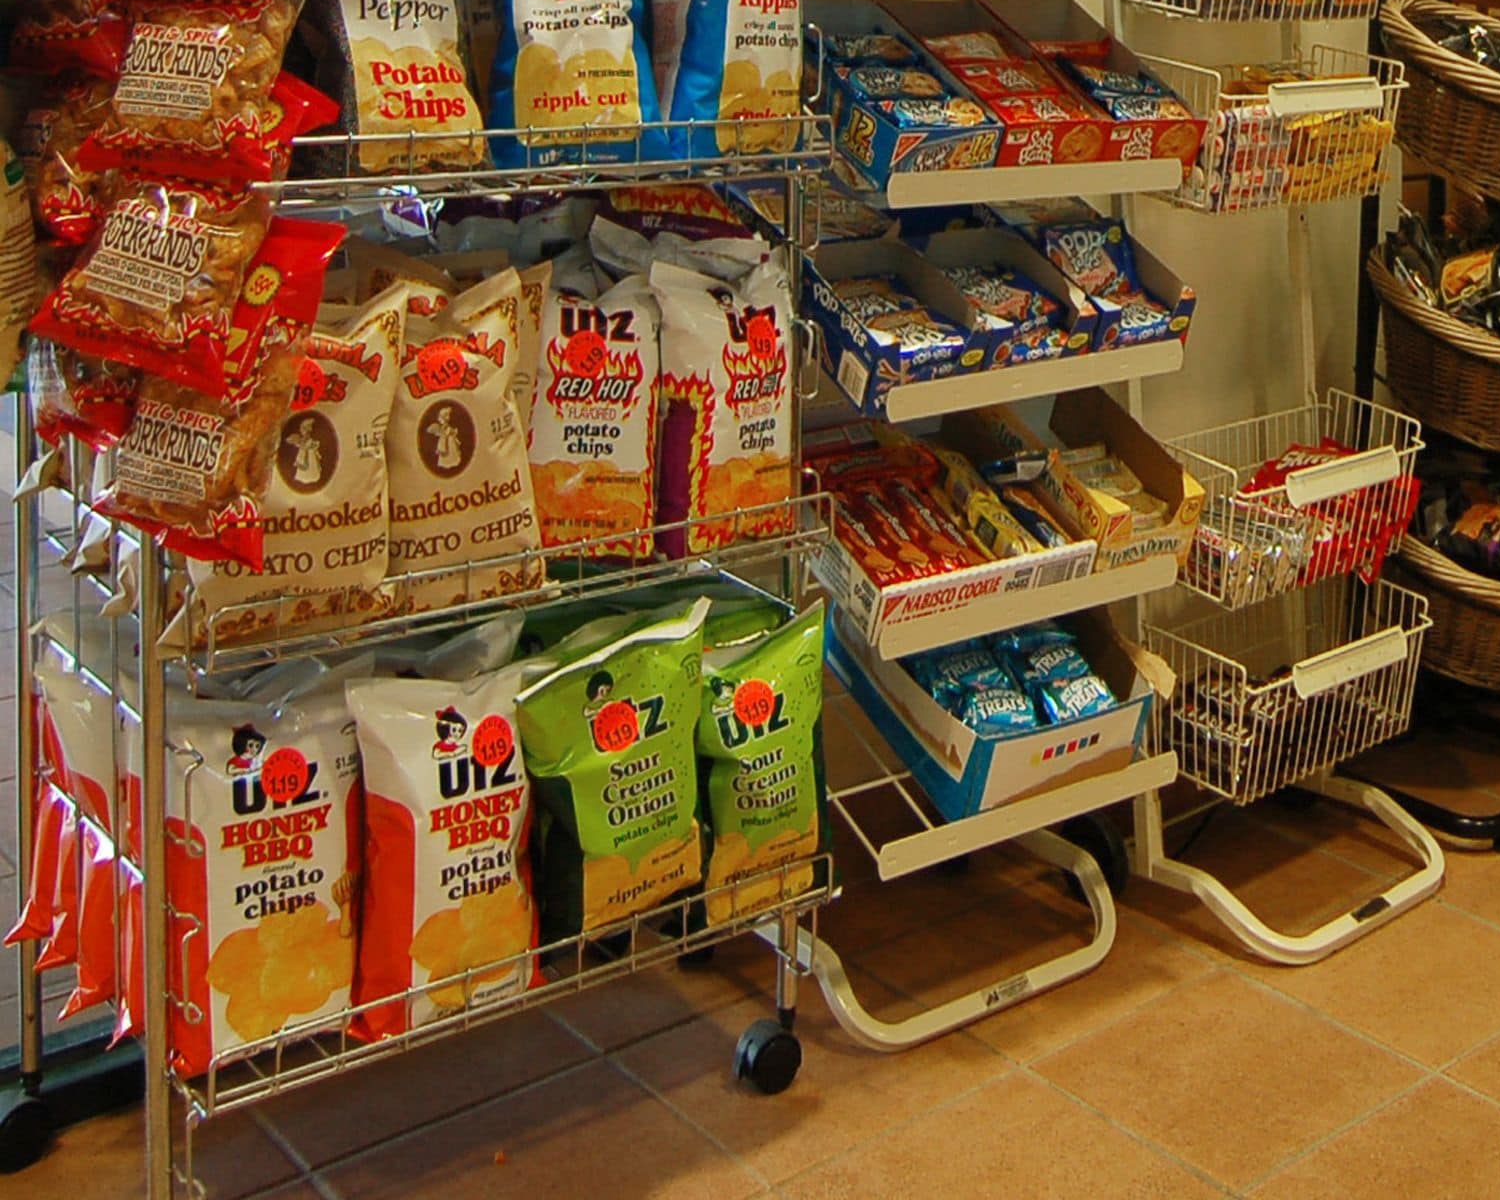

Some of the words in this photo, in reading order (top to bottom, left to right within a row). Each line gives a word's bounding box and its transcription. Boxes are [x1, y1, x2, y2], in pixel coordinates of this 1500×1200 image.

[523, 16, 580, 36] potato
[734, 32, 777, 50] potato
[168, 43, 230, 81] RINDS
[370, 61, 463, 86] Potato
[378, 89, 467, 123] Chips
[532, 90, 591, 112] ripple
[596, 90, 628, 106] cut
[141, 224, 206, 275] RINDS
[430, 359, 460, 387] 1.19
[554, 376, 595, 399] RED
[596, 378, 637, 401] HOT
[733, 378, 760, 400] RED
[175, 409, 223, 433] SPICY
[568, 407, 617, 421] FLAVORED
[562, 423, 621, 442] potato
[739, 419, 777, 440] potato
[740, 435, 776, 452] chips
[162, 423, 222, 473] RINDS
[566, 438, 614, 456] chips
[263, 495, 384, 534] ndcooked
[471, 508, 534, 543] CHIPS
[323, 535, 387, 569] CHIPS
[901, 587, 956, 615] NABISCO
[956, 575, 1003, 603] COOKIE
[743, 698, 769, 720] 1.19
[976, 695, 1026, 720] TREATS
[481, 737, 507, 762] 1.19
[604, 723, 633, 749] 1.19
[608, 752, 662, 782] Sour
[738, 748, 785, 776] Sour
[268, 772, 299, 795] 1.19
[602, 770, 676, 805] Cream
[731, 763, 798, 794] Cream
[429, 786, 525, 833] HONEY
[607, 793, 676, 827] Onion
[736, 785, 798, 810] Onion
[220, 803, 332, 849] HONEY
[448, 814, 511, 851] BBQ
[613, 827, 650, 847] potato
[242, 833, 314, 868] BBQ
[440, 848, 513, 887] potato
[234, 867, 324, 906] potato
[448, 870, 513, 902] chips
[606, 878, 657, 905] ripple
[659, 863, 686, 887] cut
[243, 889, 316, 921] chips
